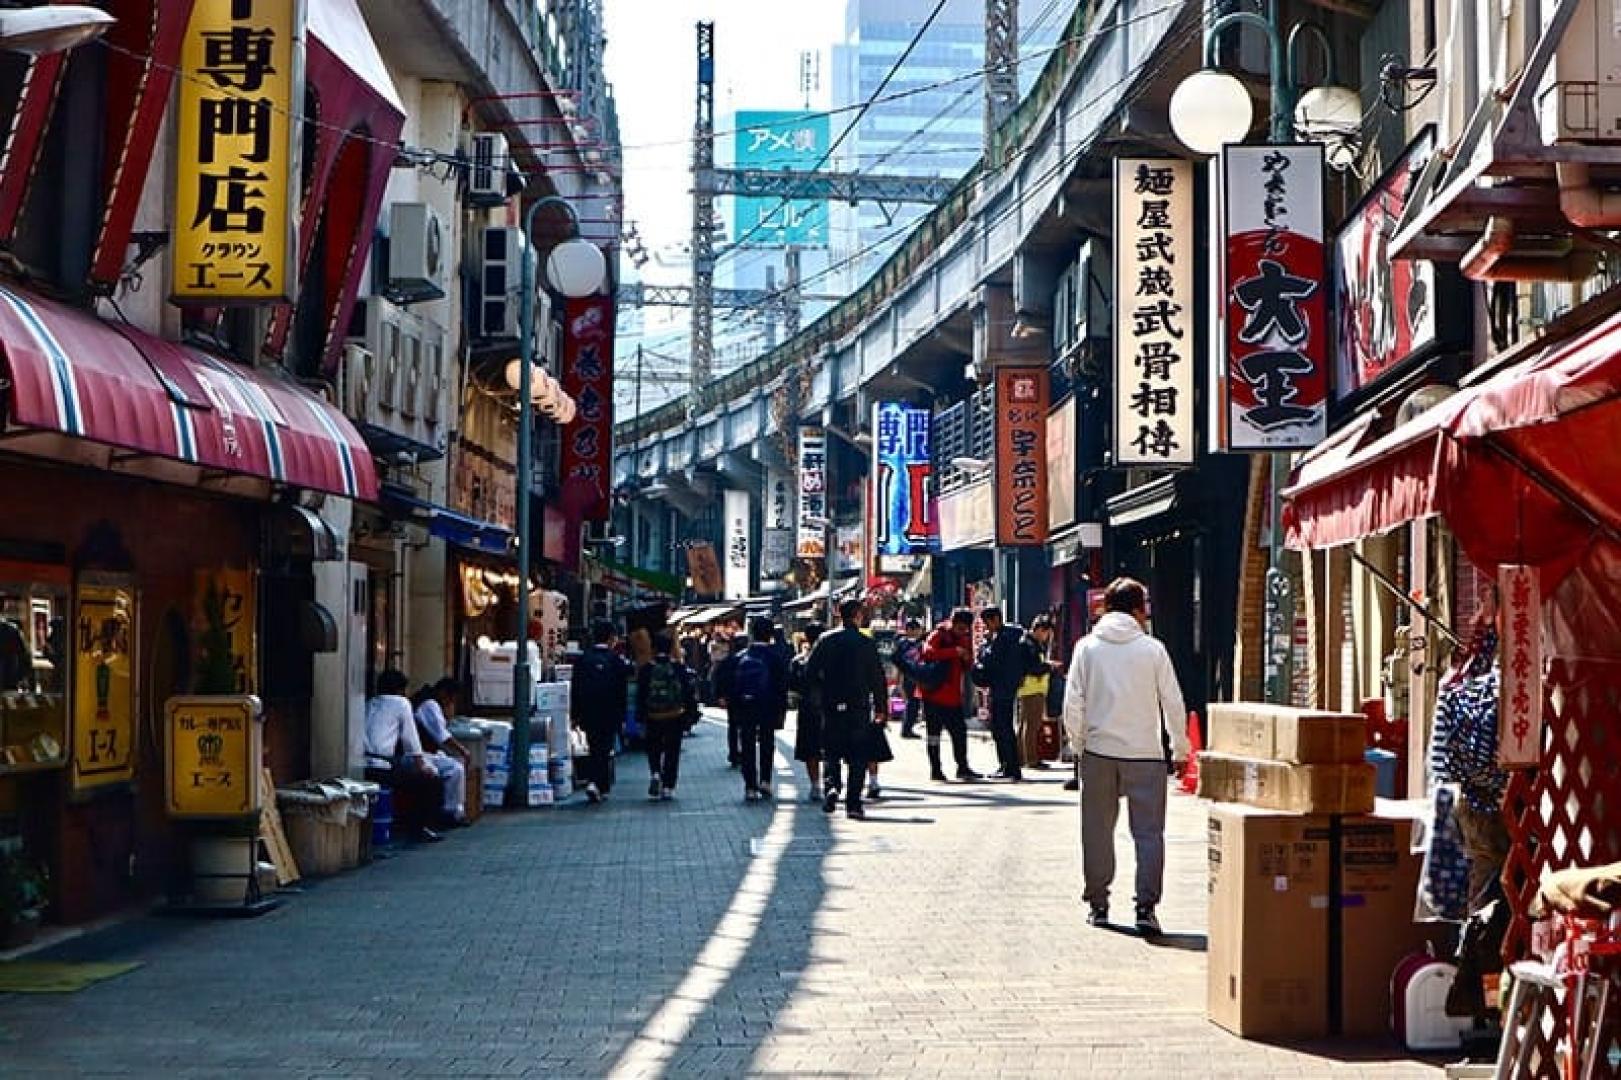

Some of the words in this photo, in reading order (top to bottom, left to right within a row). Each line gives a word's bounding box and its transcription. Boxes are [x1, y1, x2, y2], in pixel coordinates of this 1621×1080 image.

[201, 241, 261, 259] クラウン
[187, 261, 273, 290] エース
[1232, 259, 1318, 432] 大王
[190, 770, 233, 788] エース
